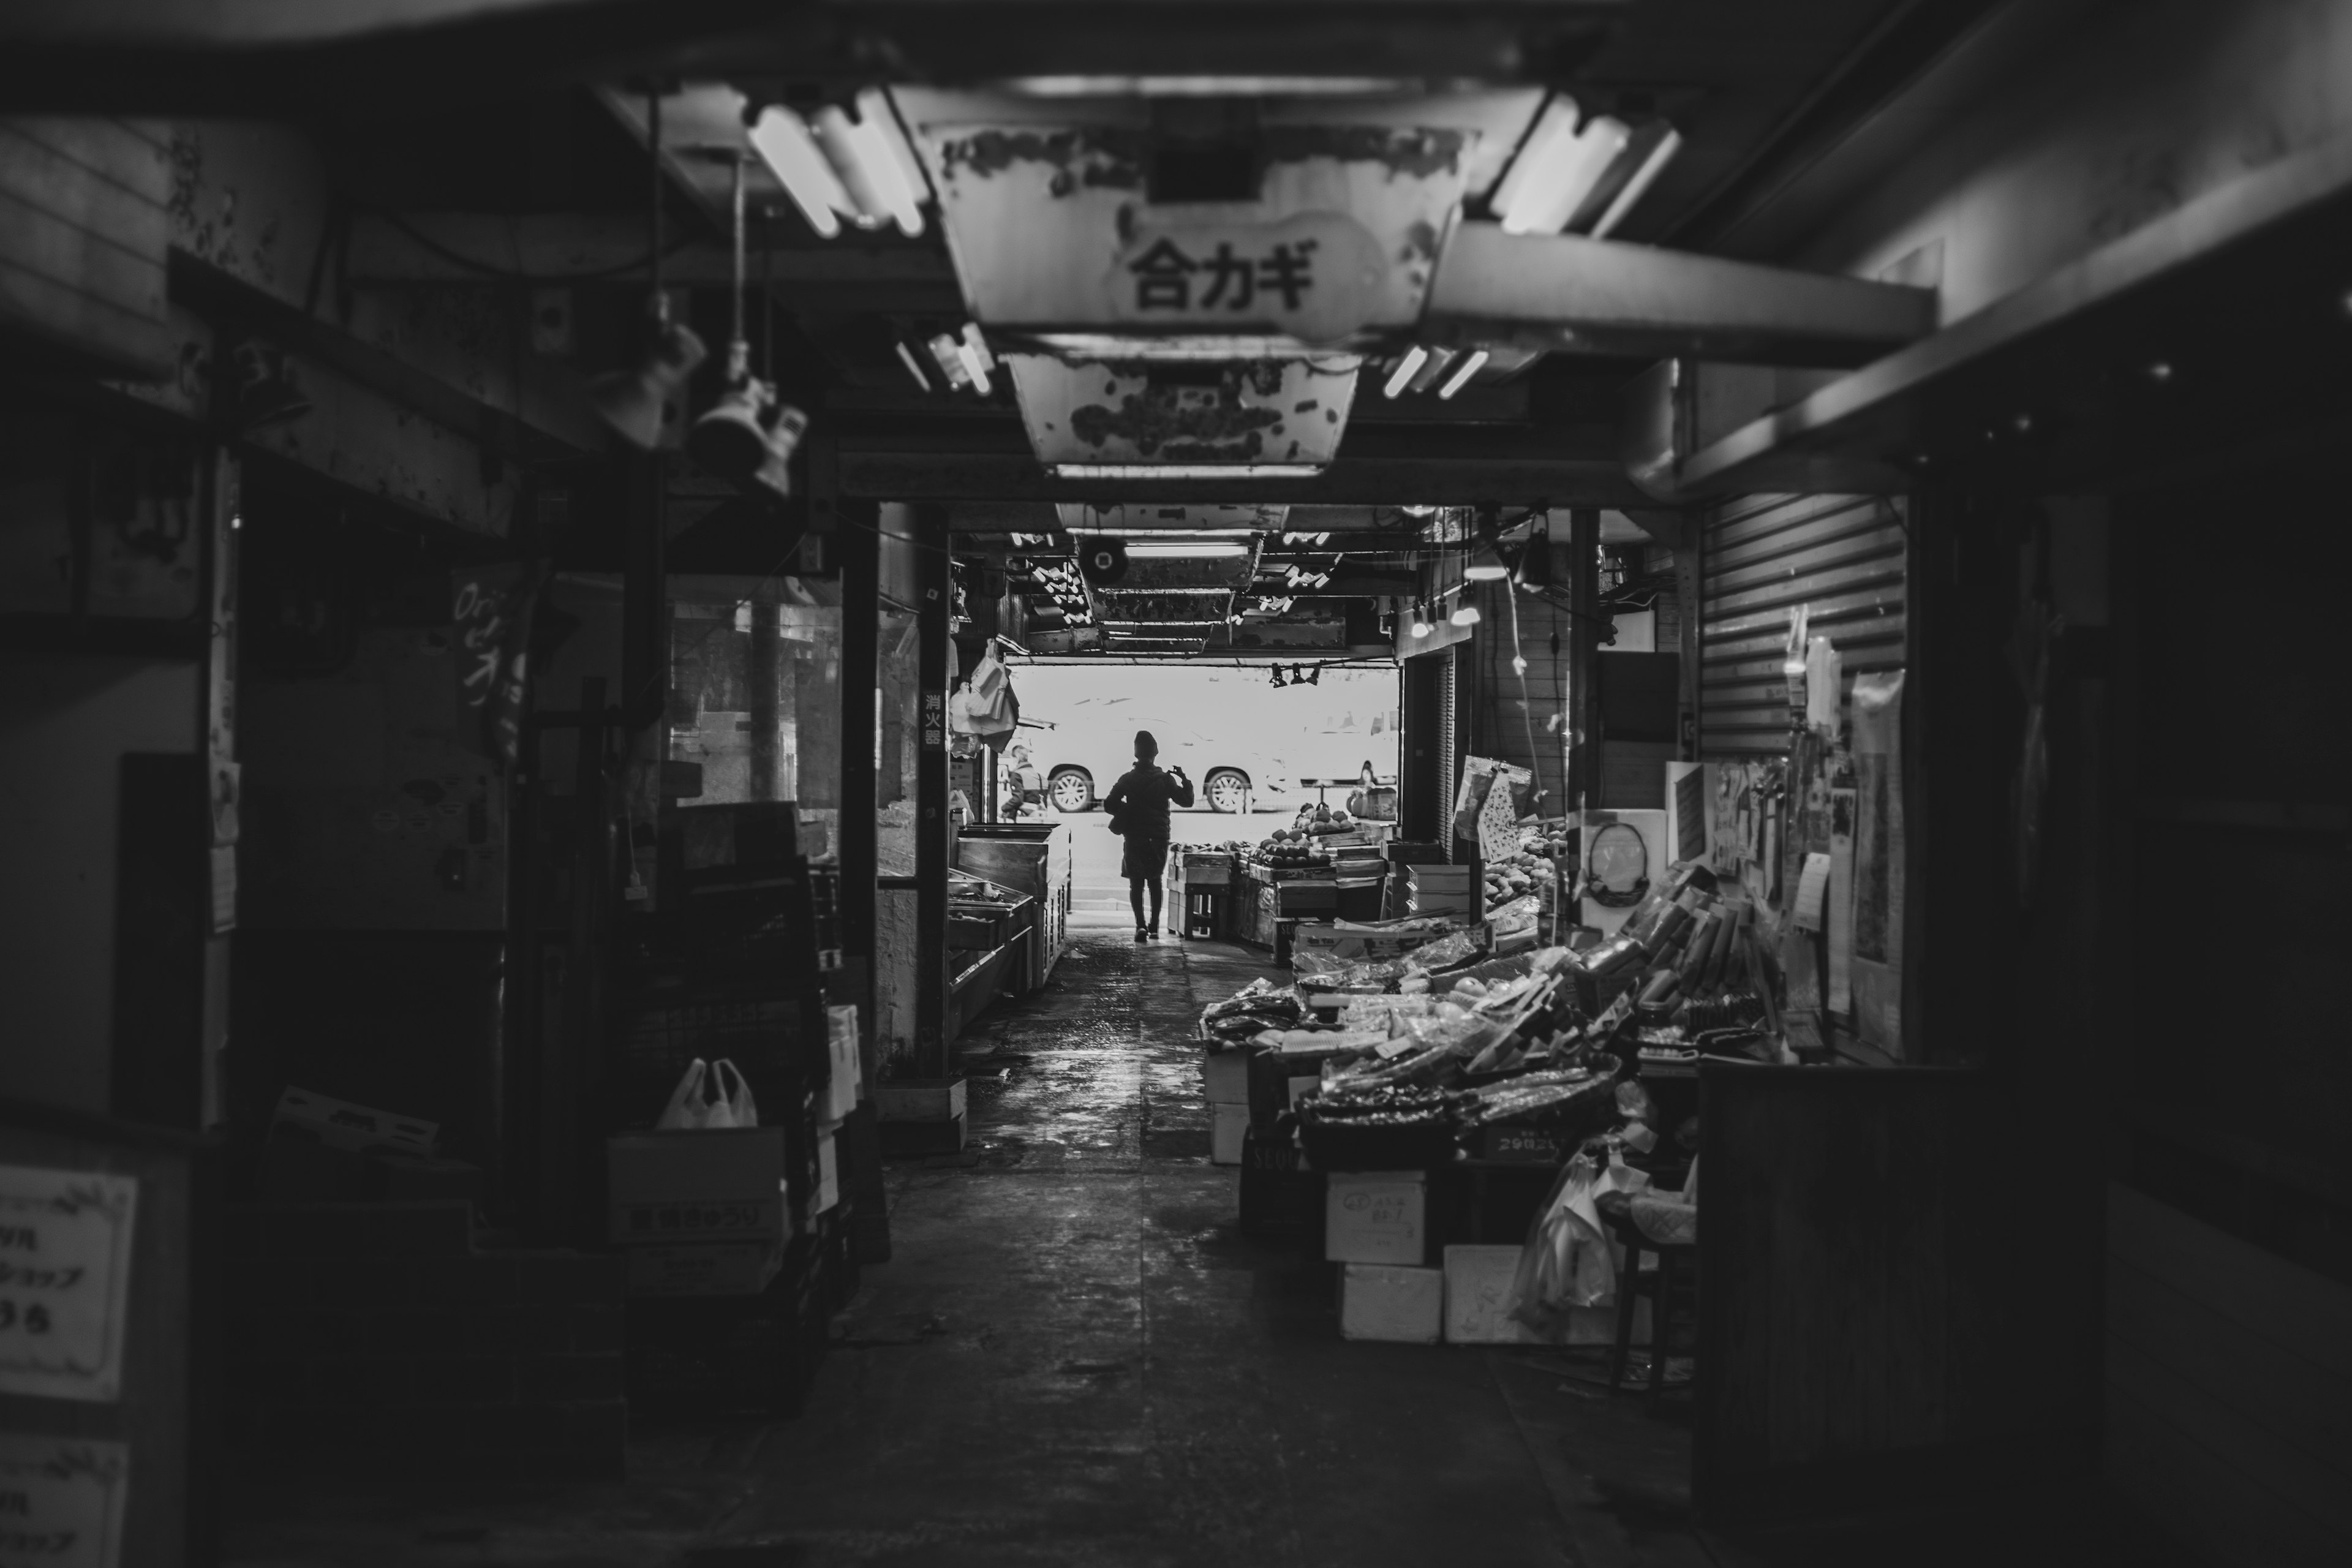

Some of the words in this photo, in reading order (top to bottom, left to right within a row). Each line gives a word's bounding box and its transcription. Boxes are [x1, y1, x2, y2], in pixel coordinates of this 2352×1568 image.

[1129, 238, 1317, 311] 合カギ
[925, 694, 941, 745] 消火器
